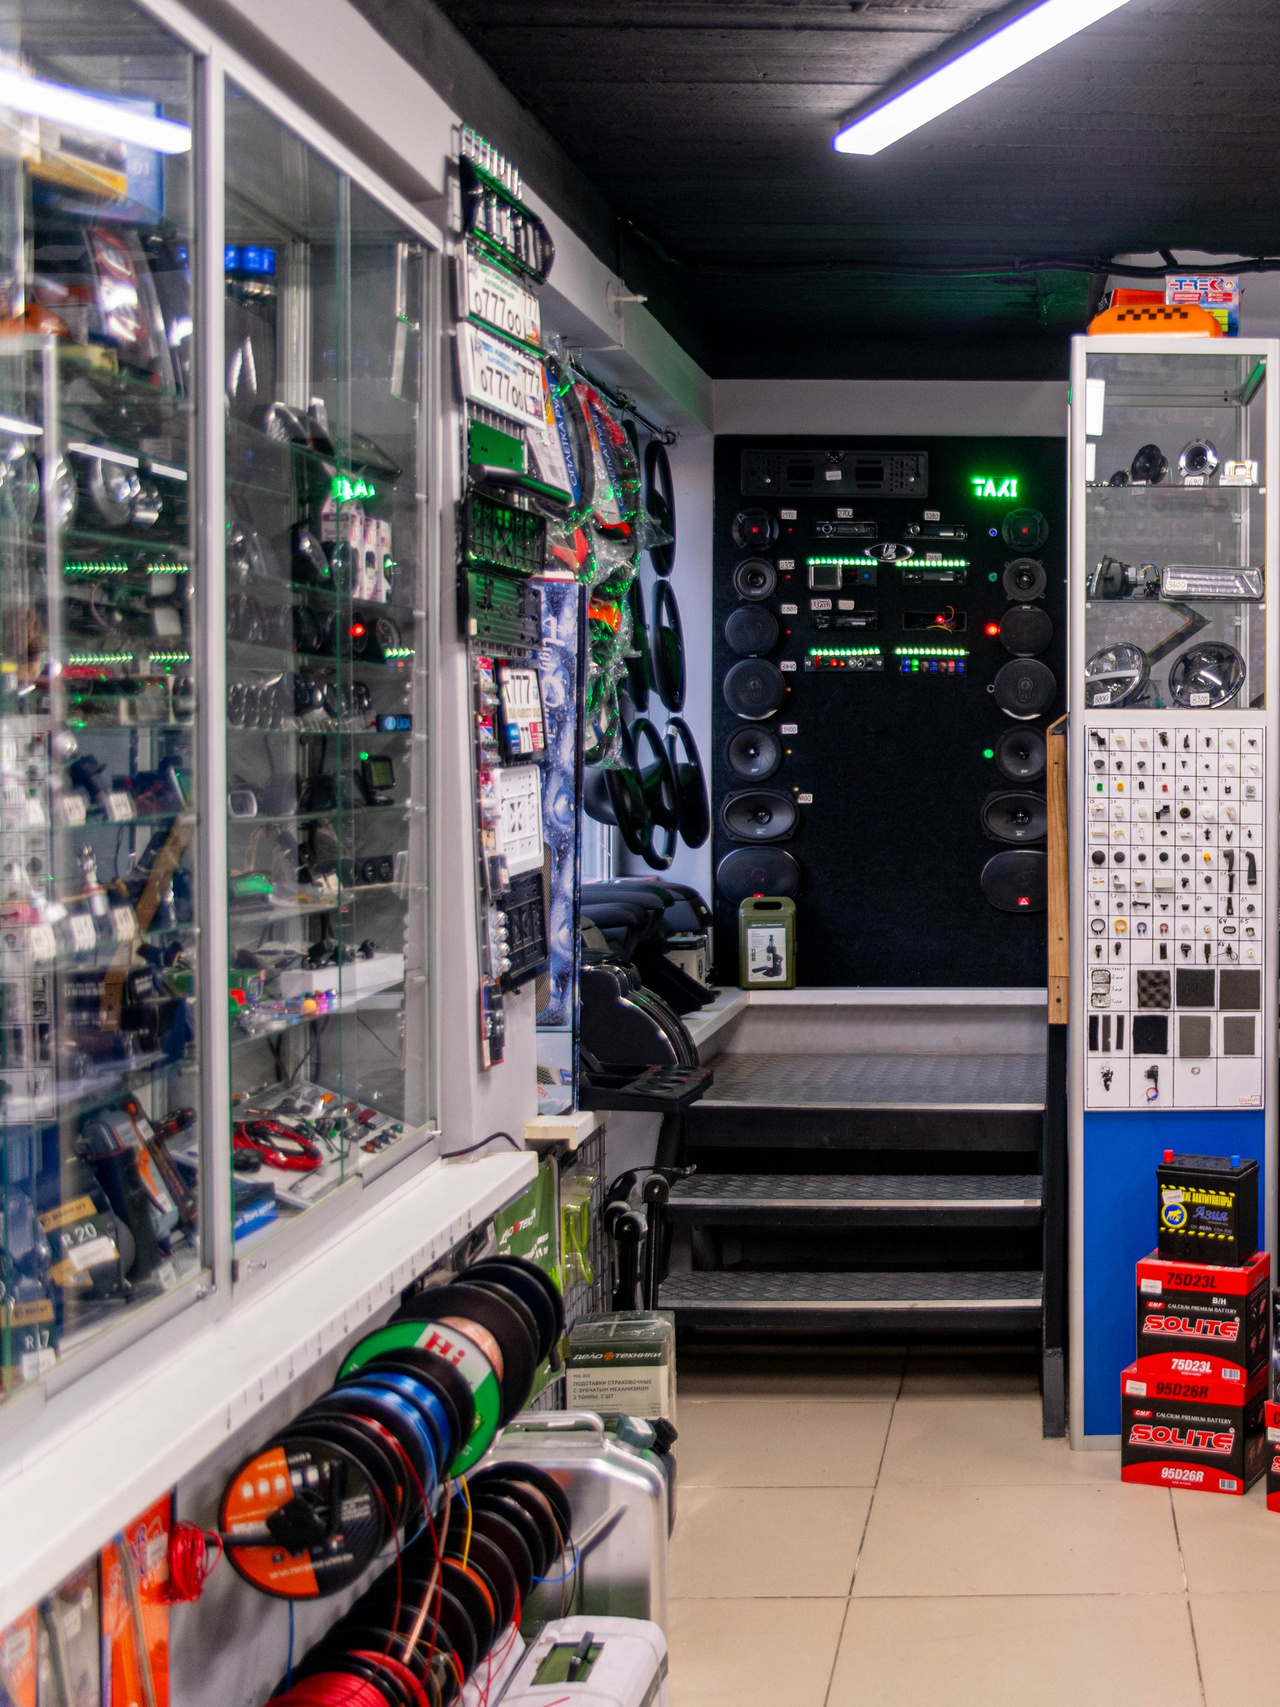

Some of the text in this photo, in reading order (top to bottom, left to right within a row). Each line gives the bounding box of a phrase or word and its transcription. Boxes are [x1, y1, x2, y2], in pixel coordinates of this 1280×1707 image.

[1170, 279, 1221, 291] TREK
[972, 478, 1018, 498] TAXI
[1192, 1205, 1229, 1222] Азия
[1166, 1272, 1218, 1289] 75D23L
[1190, 1305, 1214, 1313] PREMIUM
[1211, 1296, 1227, 1306] B/H
[1143, 1315, 1240, 1341] SOLITE
[423, 1331, 466, 1367] Hi
[1170, 1358, 1213, 1373] 75D23L
[1155, 1381, 1209, 1399] 95D26R
[1135, 1409, 1232, 1425] CMF CALCIUM PREMIUM BATTERY
[1129, 1424, 1235, 1454] SOLITE
[1160, 1467, 1205, 1483] 95D26R
